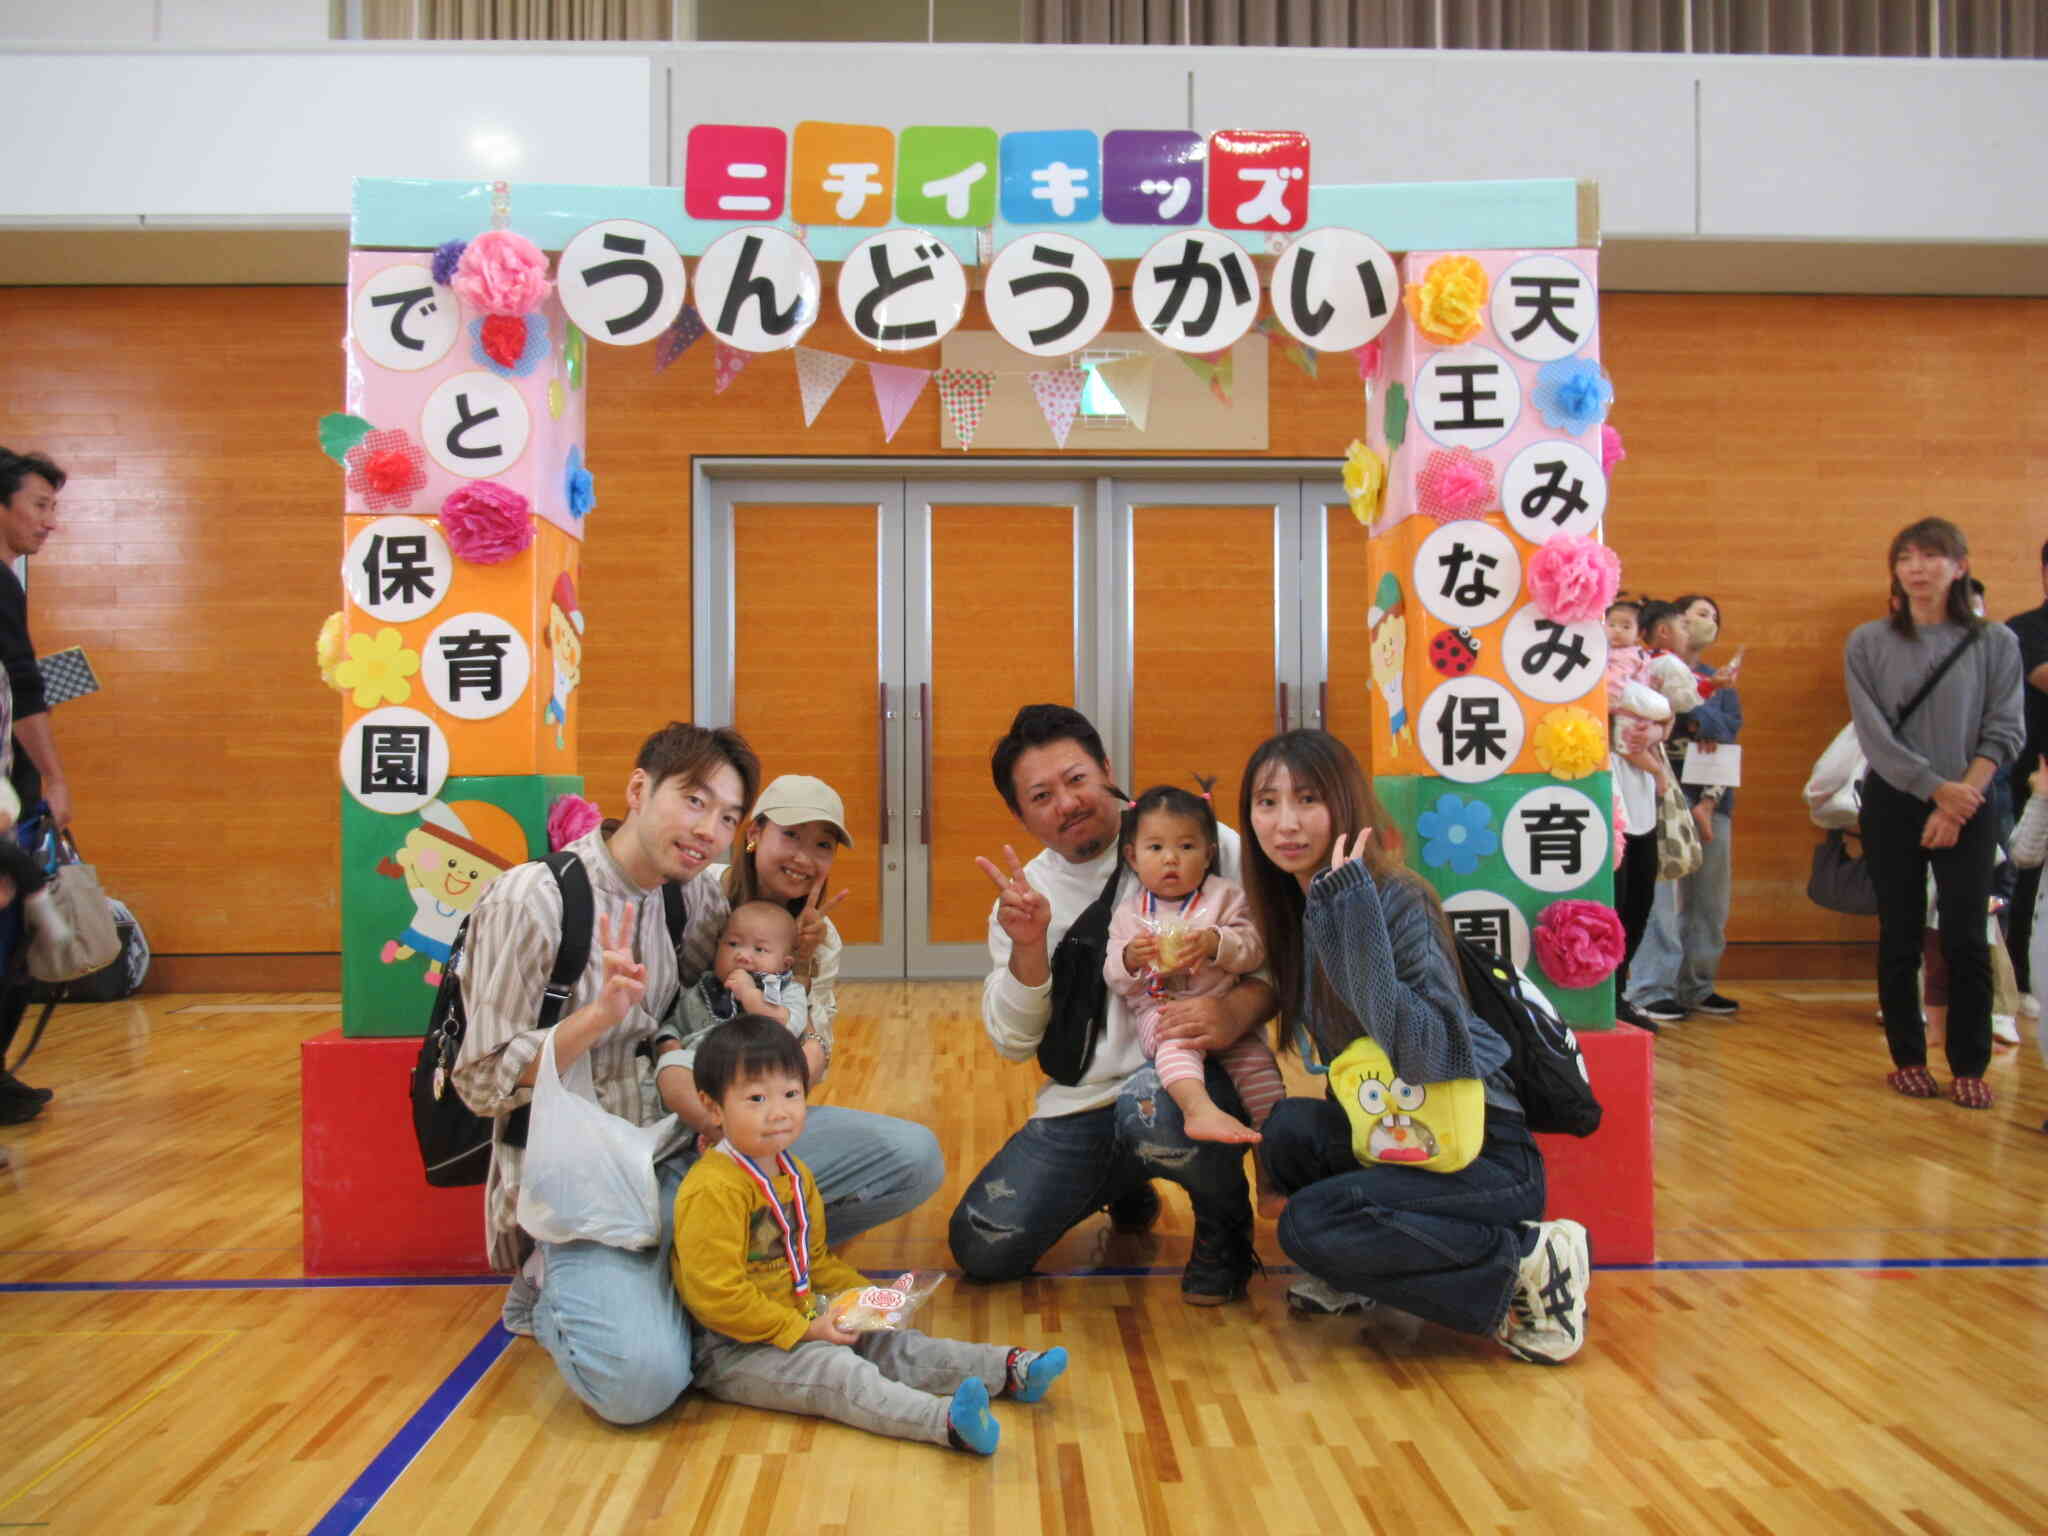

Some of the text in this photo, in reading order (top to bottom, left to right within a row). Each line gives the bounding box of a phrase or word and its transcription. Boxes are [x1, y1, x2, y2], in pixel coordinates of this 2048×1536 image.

[717, 160, 1303, 225] ニチイキッズ
[581, 231, 1389, 346] うんどうかい
